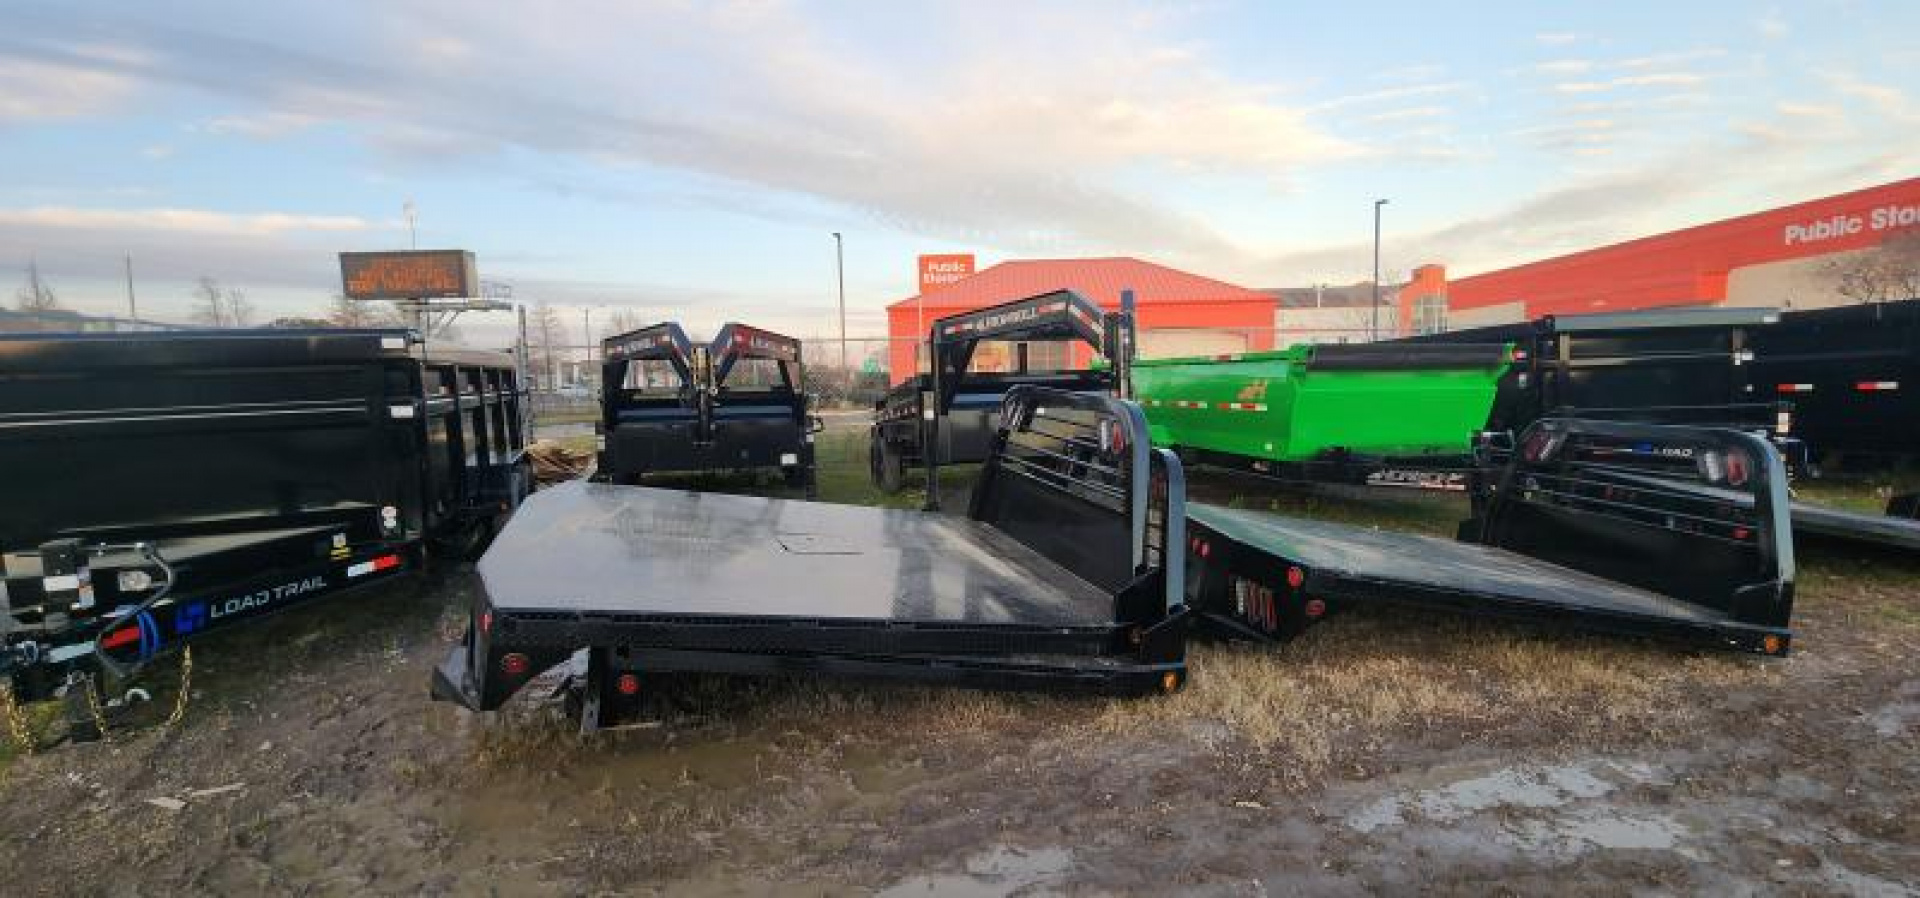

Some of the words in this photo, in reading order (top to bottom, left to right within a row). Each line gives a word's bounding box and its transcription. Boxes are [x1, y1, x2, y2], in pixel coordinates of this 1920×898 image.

[1785, 215, 1863, 245] Public
[210, 590, 270, 618] LOAD
[271, 575, 328, 600] TRAIL
